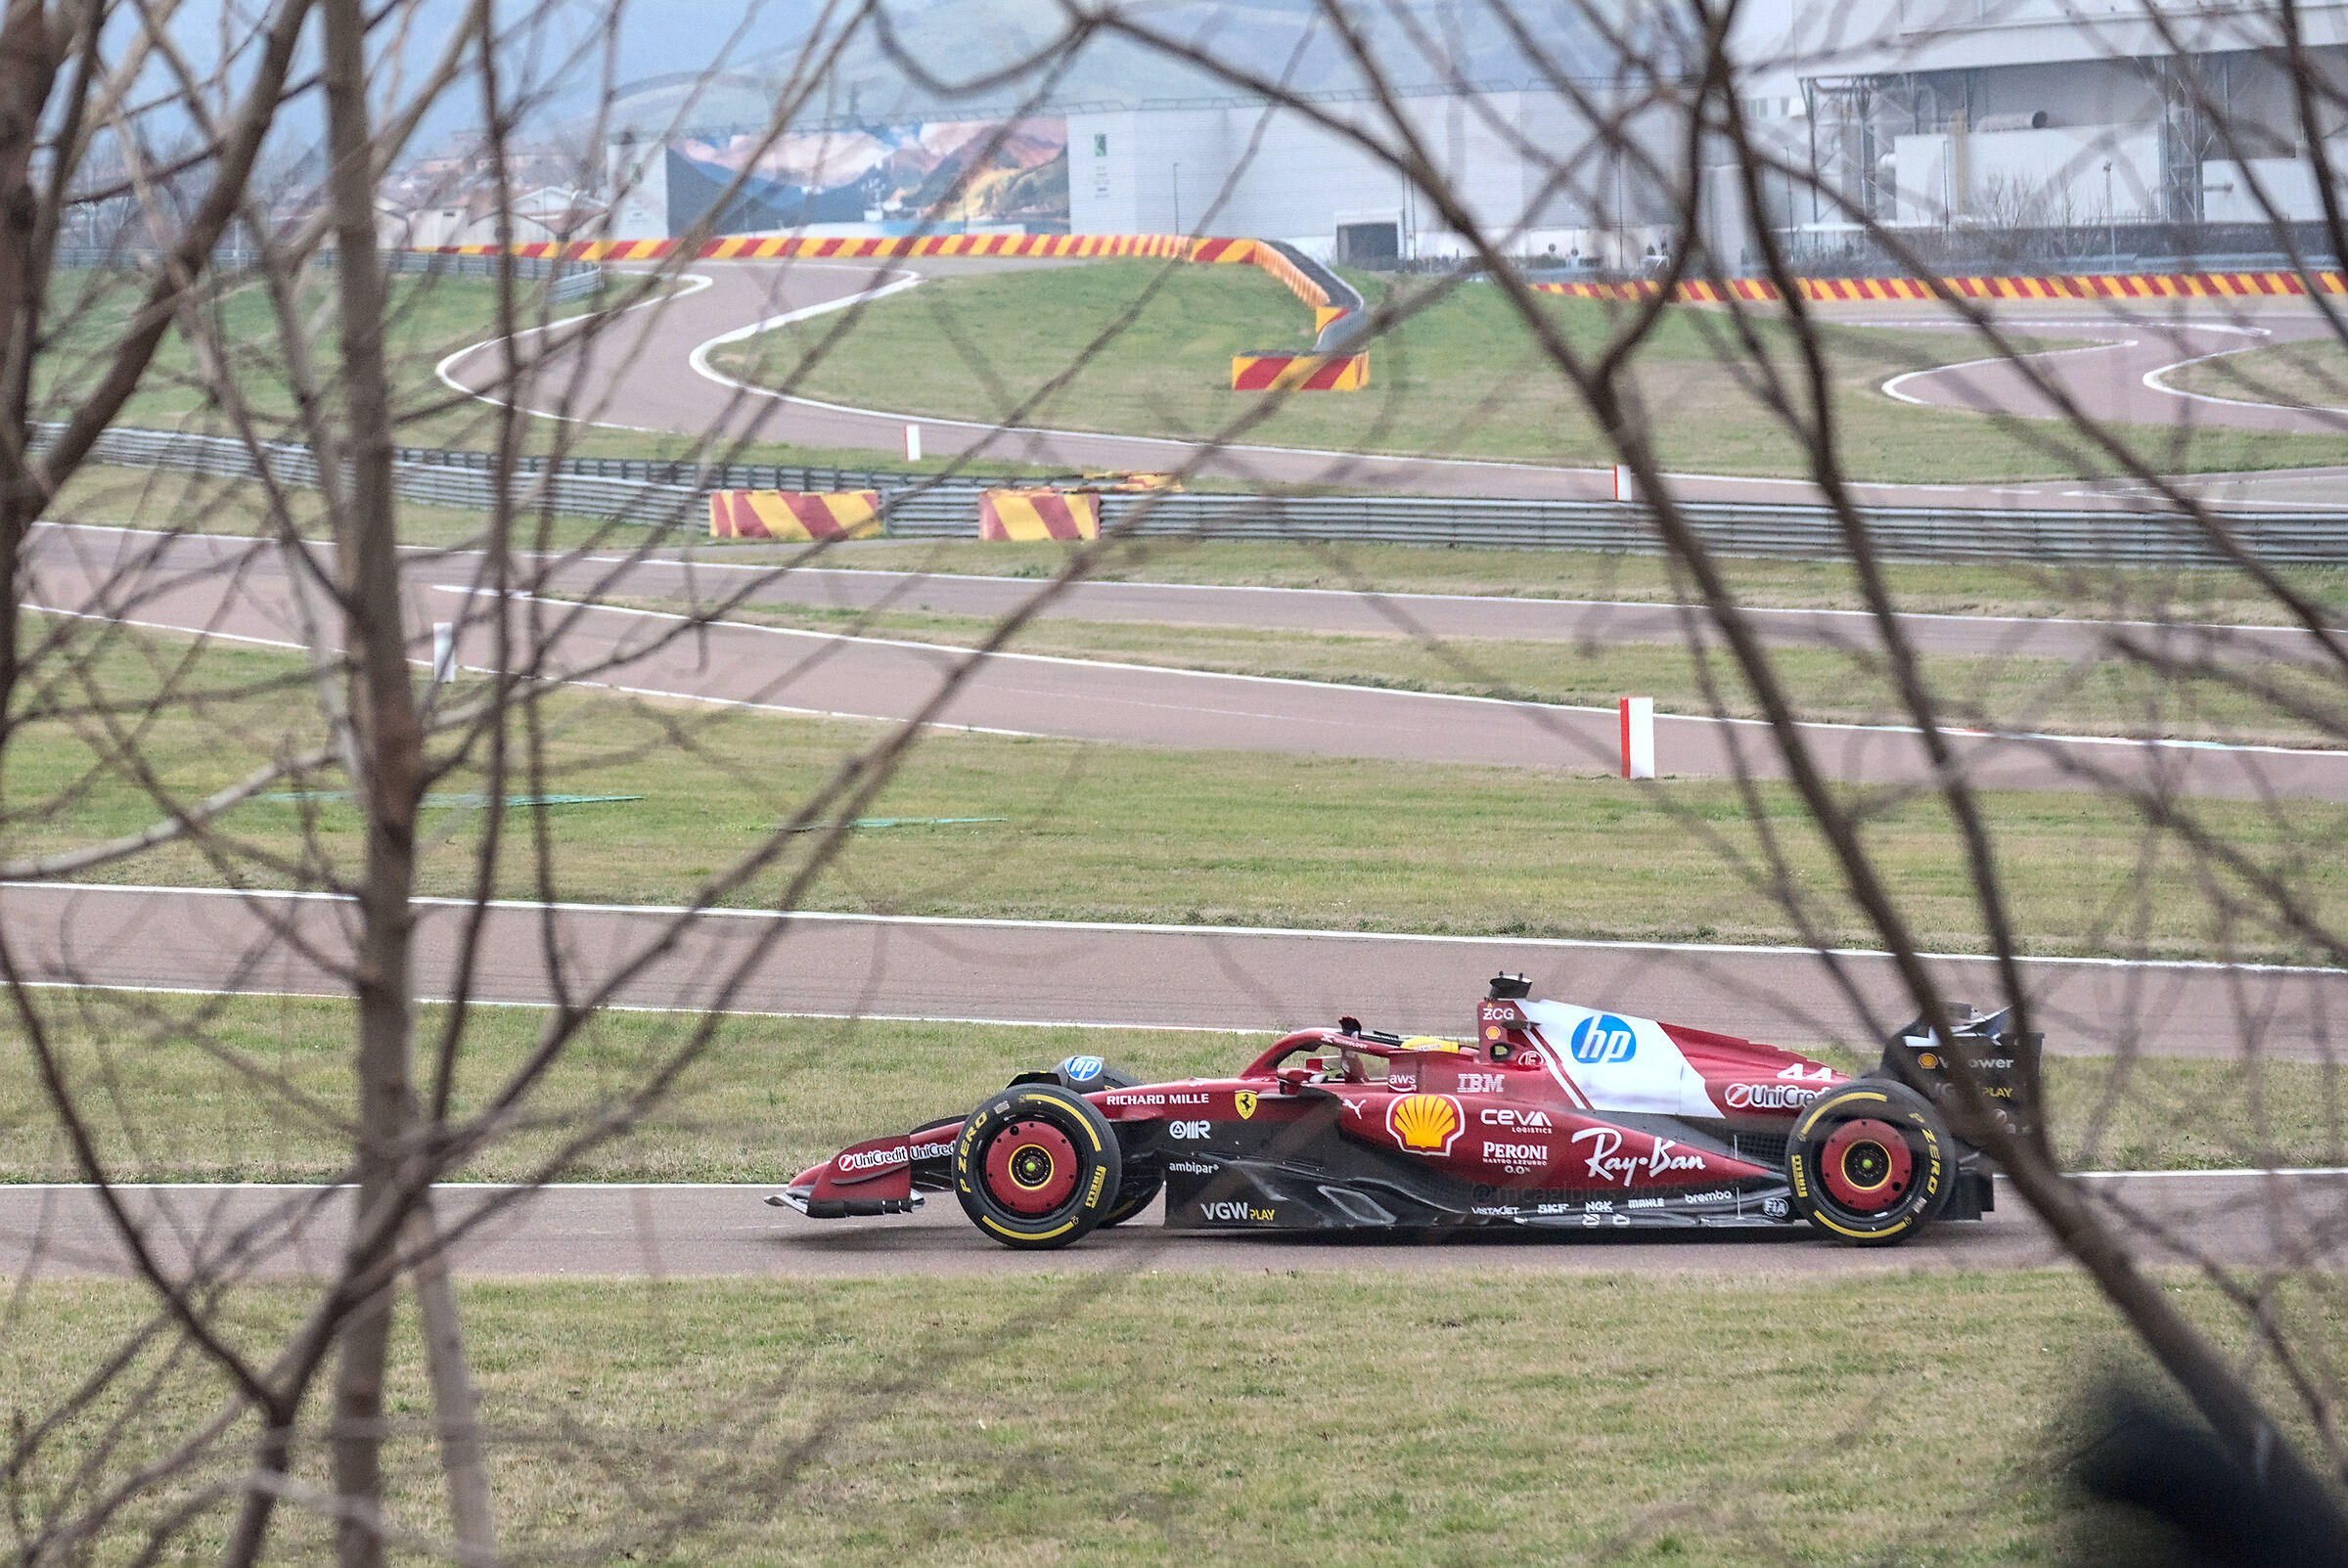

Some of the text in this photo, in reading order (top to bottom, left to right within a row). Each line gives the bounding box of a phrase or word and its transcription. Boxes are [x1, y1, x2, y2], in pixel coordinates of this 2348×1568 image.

[1482, 1008, 1514, 1020] ZCG
[1576, 1013, 1633, 1063] hp
[1069, 1055, 1099, 1080] hp
[1777, 1062, 1832, 1082] 44
[1389, 1074, 1417, 1085] aws
[1456, 1073, 1506, 1094] IBM
[1106, 1093, 1210, 1105] RICHARD MILLE
[1751, 1085, 1818, 1106] UniCre
[1512, 1126, 1553, 1135] LOGISTICS
[853, 1145, 908, 1167] UniCredit
[958, 1111, 988, 1193] P ZERO
[1482, 1141, 1548, 1160] PERONI
[1571, 1126, 1706, 1187] Ray-Ban
[1909, 1111, 1941, 1195] P ZERO
[1169, 1161, 1213, 1176] ambipar
[1791, 1154, 1809, 1198] PIRELLI
[1084, 1164, 1107, 1209] PIRELLI
[1684, 1189, 1733, 1204] brembo
[1200, 1201, 1276, 1221] VGW PLAY
[1537, 1203, 1569, 1215] SKF
[1585, 1200, 1613, 1213] NGK
[1628, 1198, 1665, 1209] MAHLE
[1764, 1198, 1786, 1214] FIA
